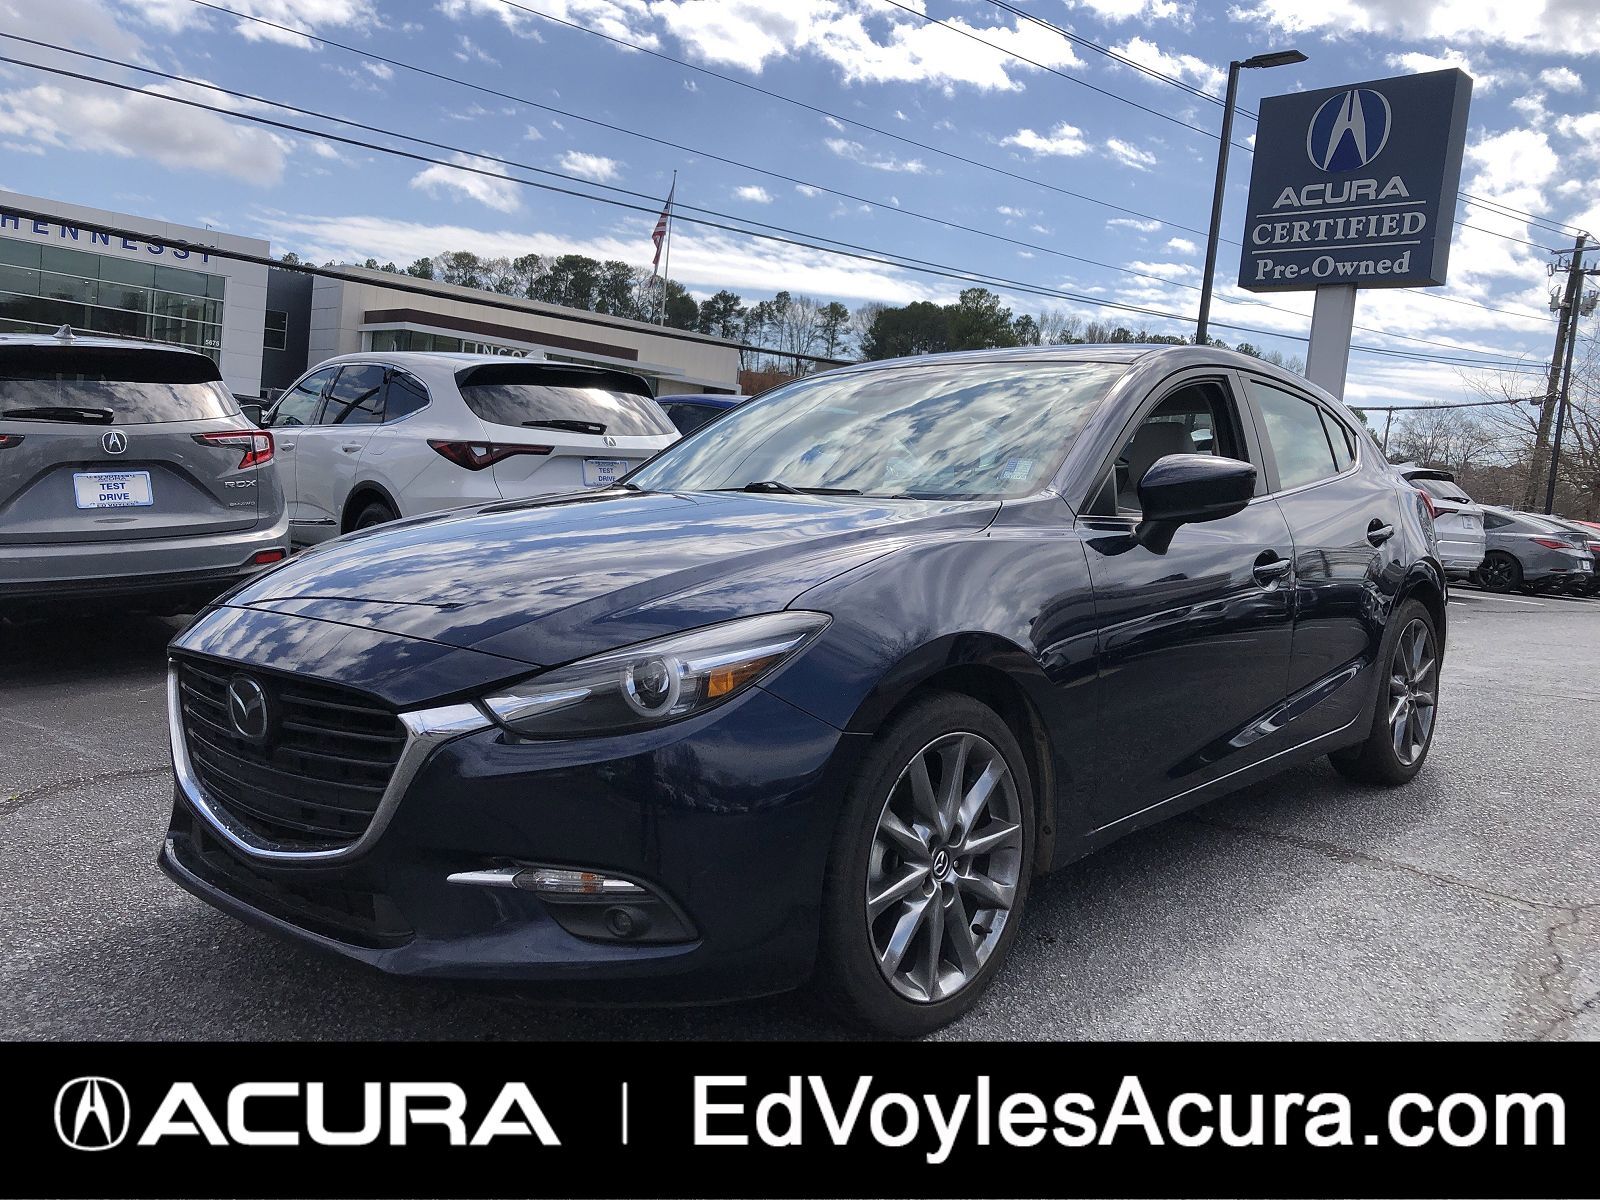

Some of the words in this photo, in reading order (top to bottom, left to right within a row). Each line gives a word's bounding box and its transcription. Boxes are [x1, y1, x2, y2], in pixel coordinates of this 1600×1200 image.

[1272, 175, 1410, 209] ACURA
[1252, 211, 1427, 245] CERTIFIED
[1255, 250, 1411, 280] Pre-Owned
[99, 482, 126, 490] TEST
[224, 479, 257, 488] RDX
[99, 492, 130, 501] DRIVE
